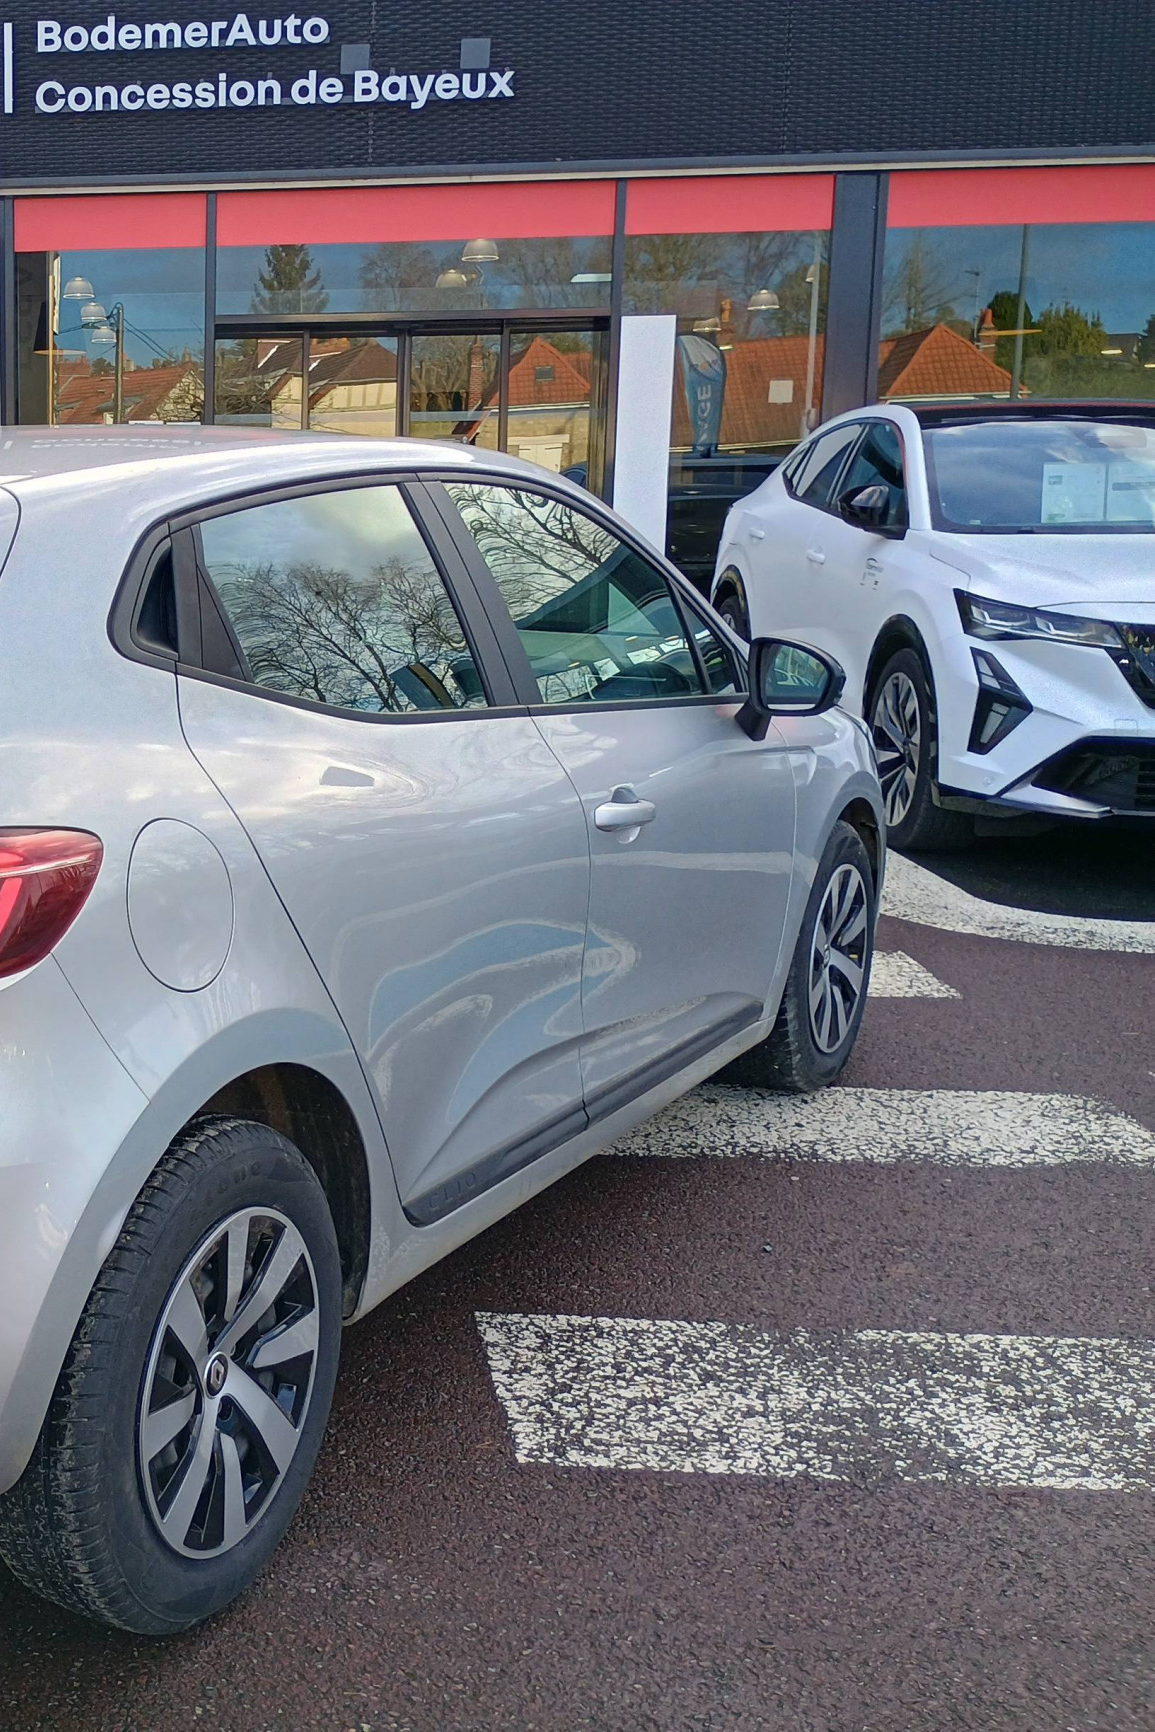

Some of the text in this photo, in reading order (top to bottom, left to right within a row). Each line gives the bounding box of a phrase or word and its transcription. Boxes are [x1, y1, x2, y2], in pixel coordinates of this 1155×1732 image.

[37, 13, 330, 52] BodemerAuto
[35, 69, 515, 113] Concession de Bayeux
